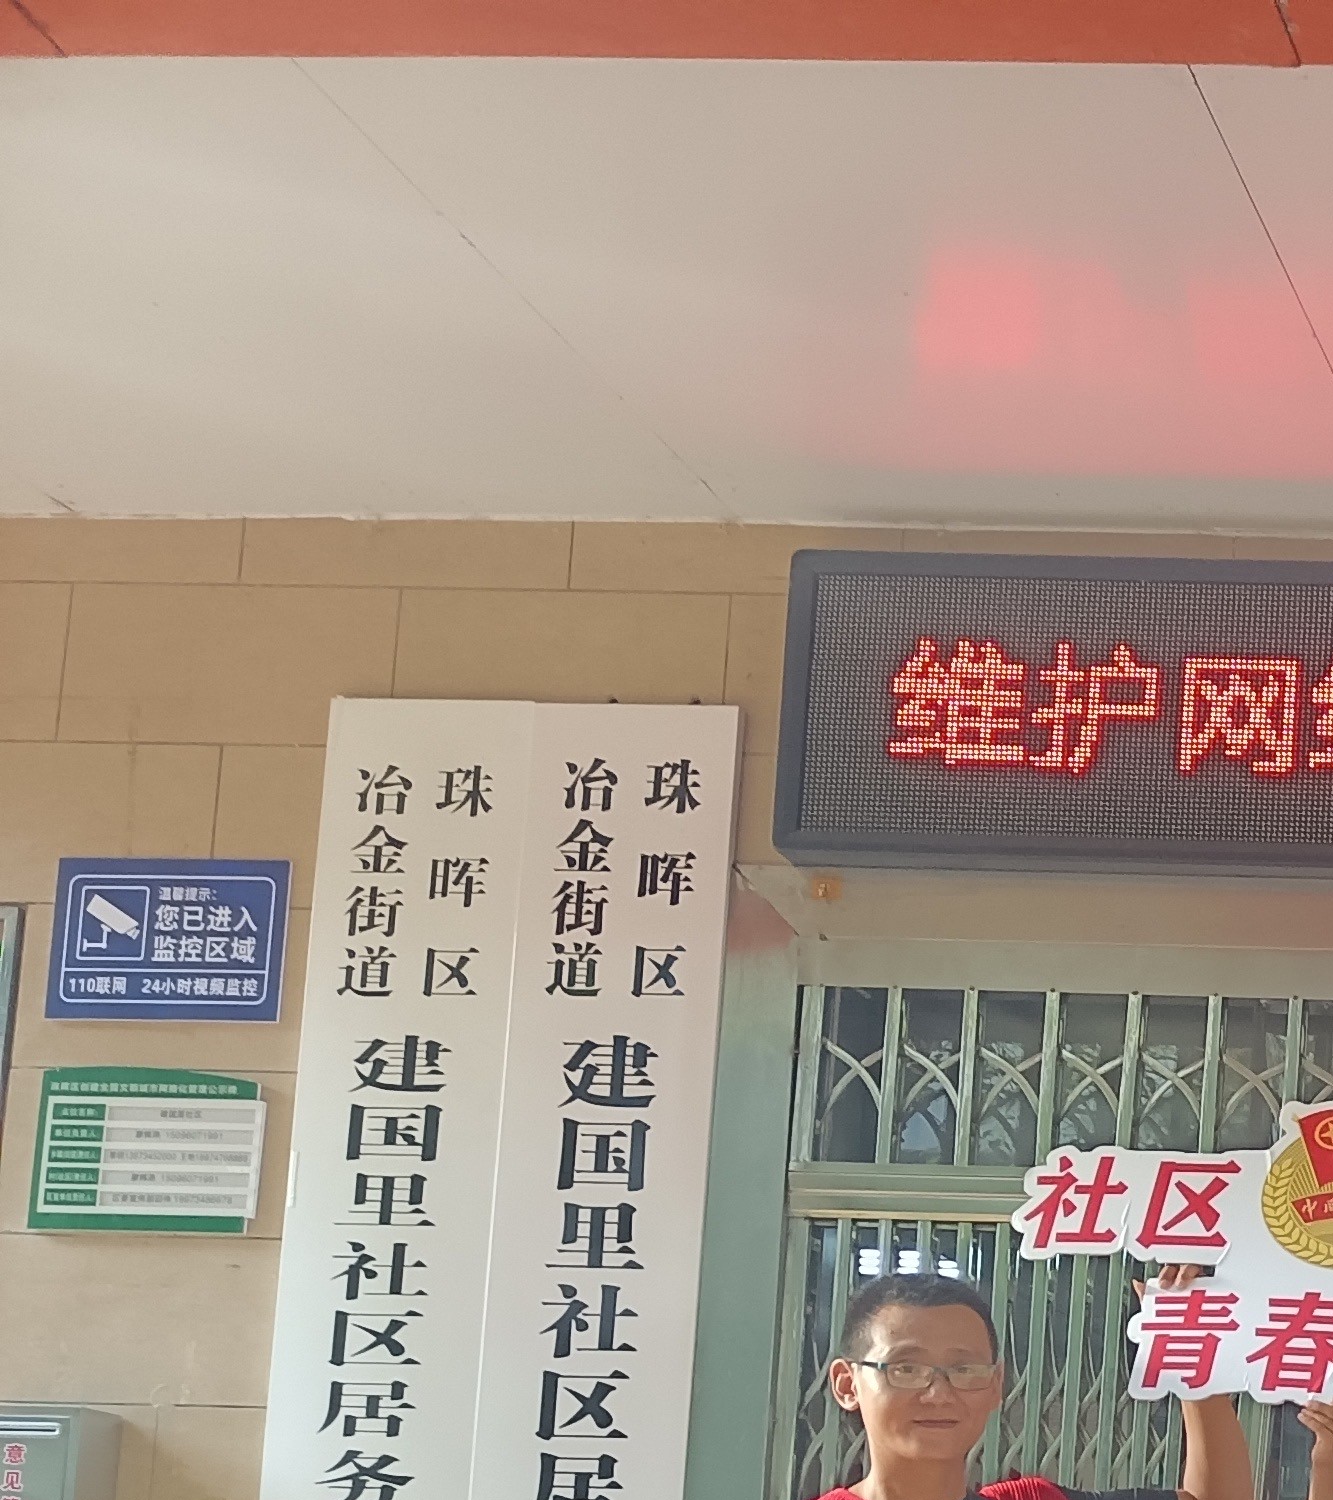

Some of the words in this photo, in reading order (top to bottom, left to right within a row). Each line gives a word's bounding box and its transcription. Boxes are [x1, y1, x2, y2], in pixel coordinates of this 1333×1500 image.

[151, 935, 257, 963] 监控区域
[154, 904, 258, 933] 您已进入
[336, 765, 413, 998] 冶金街道
[422, 765, 494, 997] 珠晖区
[545, 758, 619, 998] 冶金街道
[631, 759, 701, 997] 珠晖区
[69, 977, 127, 995] 110联网
[141, 978, 258, 997] 24小时视频监控
[1024, 1156, 1242, 1249] 社区
